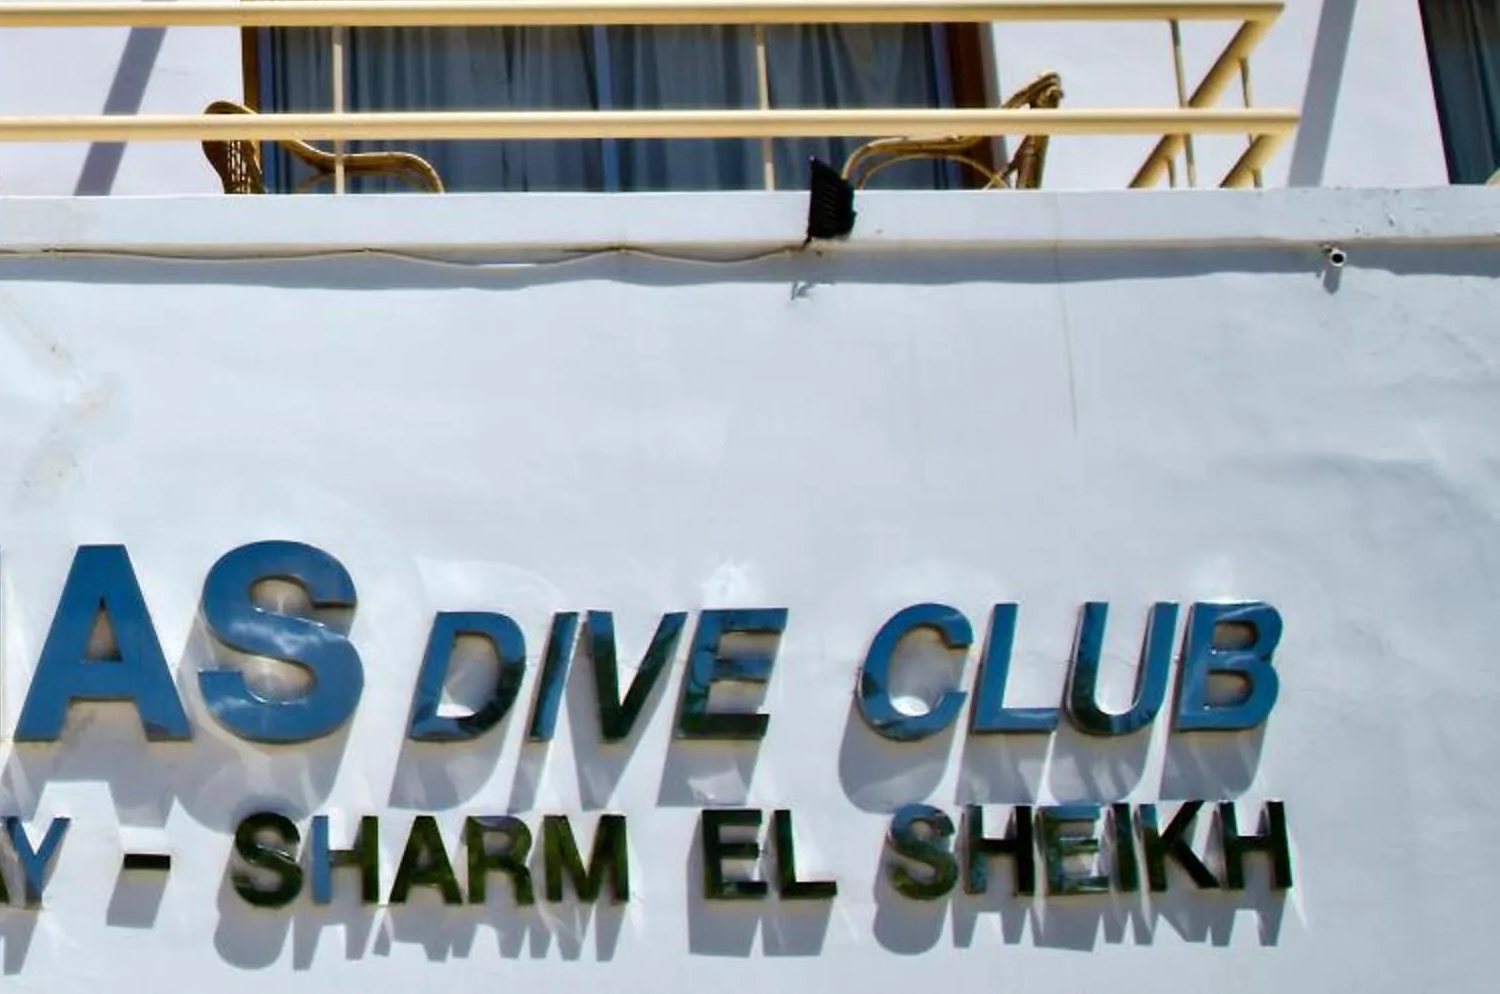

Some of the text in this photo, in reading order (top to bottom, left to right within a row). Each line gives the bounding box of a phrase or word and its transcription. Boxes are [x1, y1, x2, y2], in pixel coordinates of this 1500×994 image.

[408, 606, 789, 742] DIVE
[855, 600, 1284, 742] CLUB
[231, 809, 629, 908] SHARM
[701, 808, 838, 900] EL
[888, 799, 1293, 902] SHEIKH
